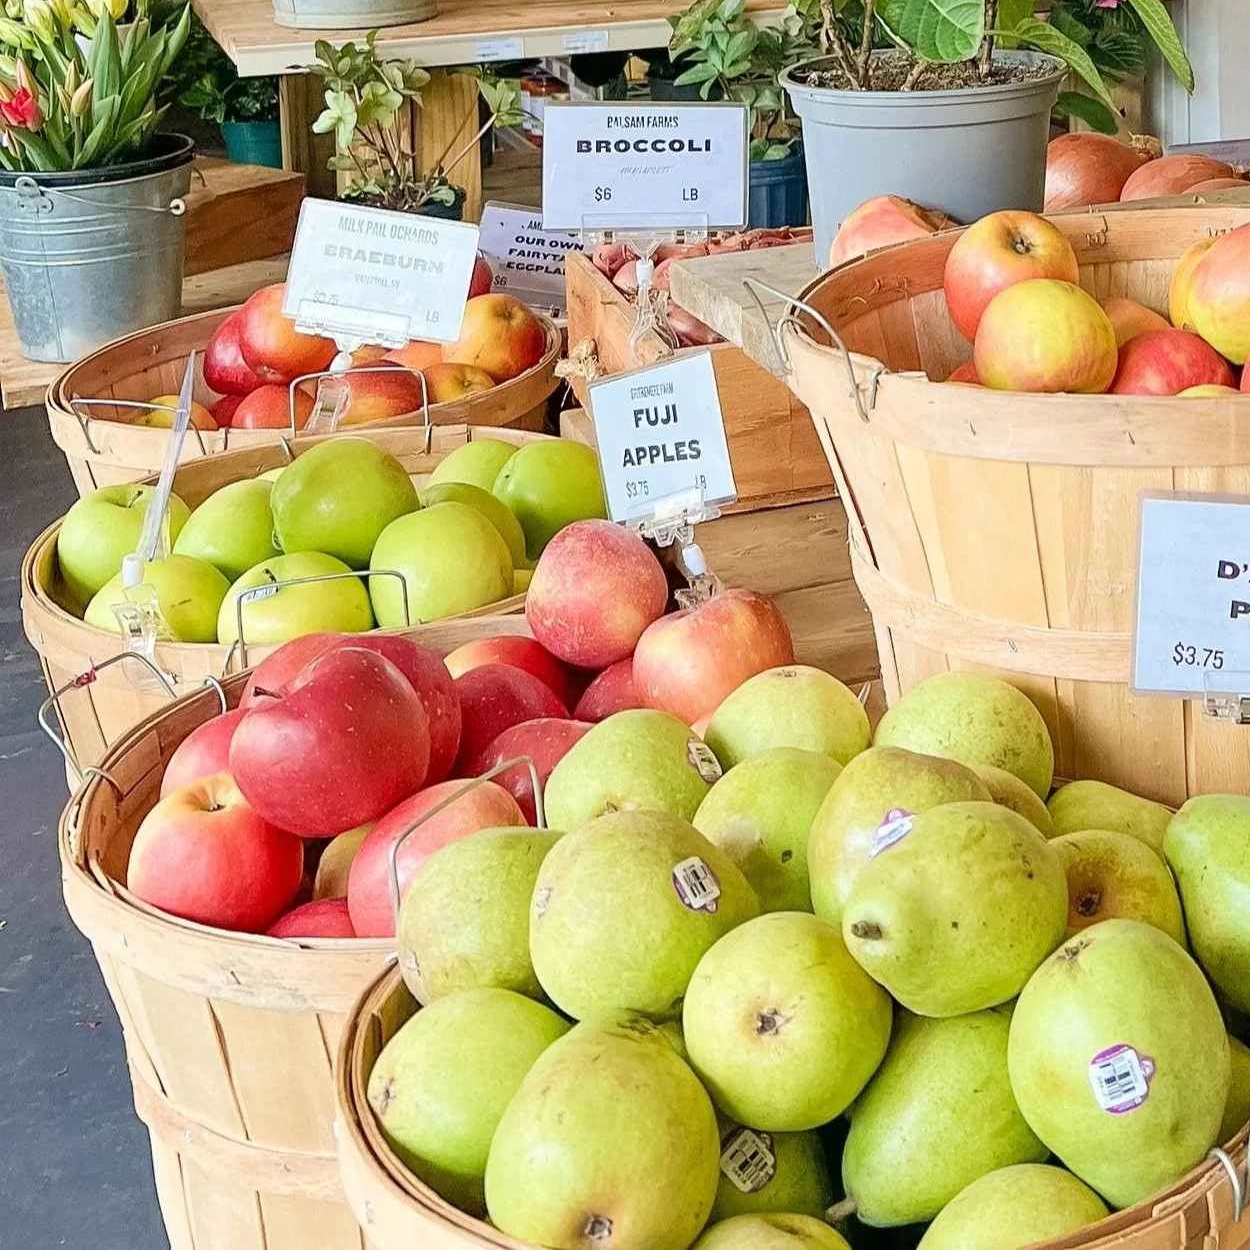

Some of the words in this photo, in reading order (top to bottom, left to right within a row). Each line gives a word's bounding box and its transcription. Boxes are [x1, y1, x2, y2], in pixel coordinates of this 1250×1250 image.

[607, 116, 645, 129] BALSAM
[647, 116, 679, 128] FARMS
[576, 139, 711, 154] BROCCOLI
[595, 186, 612, 202] $6
[682, 188, 698, 201] LB
[338, 216, 366, 234] MILK
[366, 221, 387, 237] PAIL
[515, 235, 546, 247] OUR
[549, 240, 584, 250] OWN
[324, 244, 444, 274] BRAEBURN
[506, 261, 566, 276] EGGPLA
[493, 275, 508, 286] $6
[426, 310, 440, 323] LB
[633, 403, 678, 428] FUJI
[622, 439, 702, 468] APPLES
[625, 480, 649, 498] $3.75
[1172, 641, 1224, 670] $3.75
